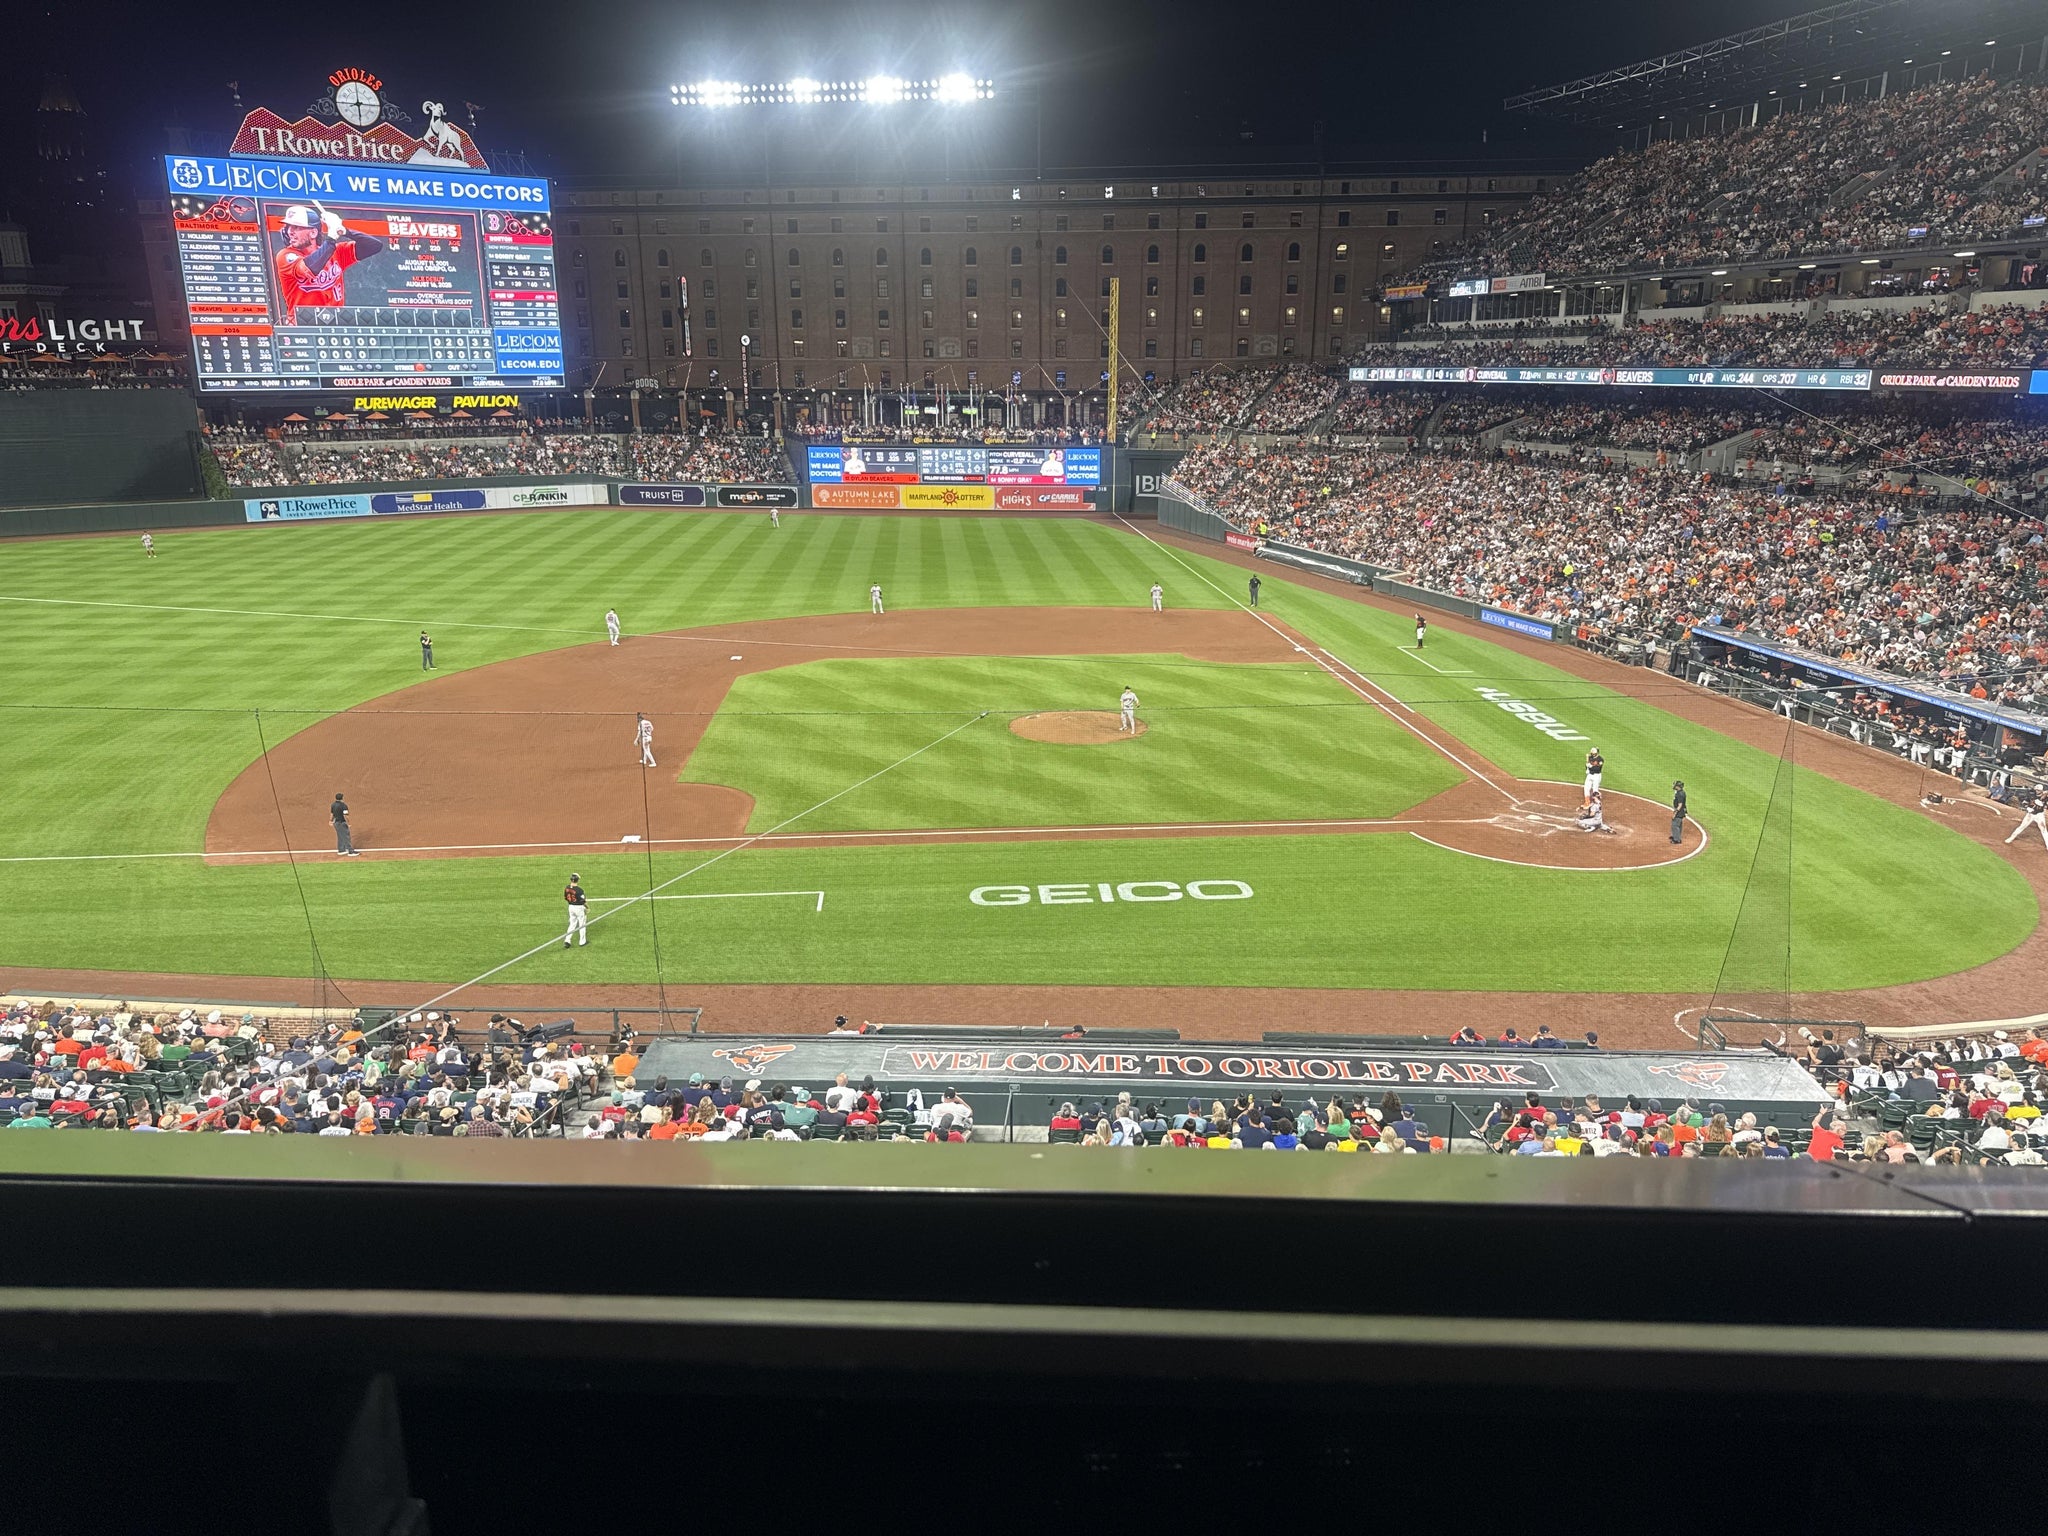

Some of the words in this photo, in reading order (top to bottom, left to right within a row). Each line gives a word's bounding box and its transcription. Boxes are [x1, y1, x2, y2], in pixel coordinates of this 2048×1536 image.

[328, 67, 383, 91] ORIOLES
[345, 133, 404, 161] Price
[348, 176, 381, 193] WE
[387, 178, 444, 197] MAKE
[450, 181, 544, 202] DOCTORS
[387, 215, 411, 223] DYLAN
[180, 222, 219, 230] BALTIMORE
[388, 223, 457, 237] BEAVERS
[48, 319, 144, 341] LIGHT
[37, 342, 106, 353] DECK
[318, 337, 326, 346] 0
[330, 337, 338, 346] 0
[343, 337, 350, 346] 0
[357, 337, 364, 346] 0
[369, 337, 377, 346] 0
[434, 338, 441, 346] 0
[445, 338, 453, 346] 2
[457, 338, 464, 346] 0
[471, 338, 478, 346] 3
[483, 338, 490, 346] 2
[319, 350, 327, 359] 0
[332, 350, 340, 359] 0
[344, 350, 352, 359] 0
[359, 350, 366, 359] 0
[435, 351, 443, 359] 0
[447, 351, 454, 359] 3
[458, 351, 466, 359] 0
[473, 351, 480, 359] 2
[484, 351, 491, 359] 0
[501, 360, 560, 369] LECOM.EDU
[1477, 371, 1508, 380] CURVEBALL
[1616, 371, 1653, 383] BEAVERS
[1688, 374, 1699, 382] B/T
[1699, 372, 1714, 384] L/R
[1721, 374, 1736, 383] AVG
[1762, 374, 1777, 383] OPS
[1777, 373, 1797, 384] .707
[1807, 375, 1818, 383] HR
[1819, 374, 1826, 384] 6
[1840, 375, 1853, 384] RBI
[1853, 374, 1867, 385] 32
[1880, 375, 1912, 386] ORIOLE
[1912, 375, 1937, 387] PARK
[1946, 375, 1987, 388] CAMDEN
[1987, 376, 2020, 388] YARDS
[333, 378, 365, 387] ORIOLE
[365, 378, 385, 387] PARK
[393, 378, 426, 387] CAMDEN
[426, 378, 451, 386] YARDS
[354, 396, 437, 409] PUREWAGER
[452, 395, 519, 408] PAVILION
[989, 466, 1008, 474] 77.8
[639, 490, 671, 500] TRUIST
[872, 491, 895, 499] LAKE
[1002, 495, 1032, 507] HIGH'S
[1050, 493, 1079, 501] CARROLL
[328, 498, 356, 510] Price
[397, 503, 433, 513] MedStar
[434, 501, 463, 510] Health
[1507, 619, 1516, 629] WE
[1515, 621, 1530, 632] MAKE
[1529, 625, 1552, 638] DOCTORS
[969, 879, 1254, 906] GEICO
[906, 1050, 1141, 1074] WELCOME
[1145, 1053, 1213, 1077] TO
[1220, 1055, 1400, 1082] ORIOLE
[1400, 1059, 1537, 1086] PARK
[1863, 1076, 1872, 1088] 4
